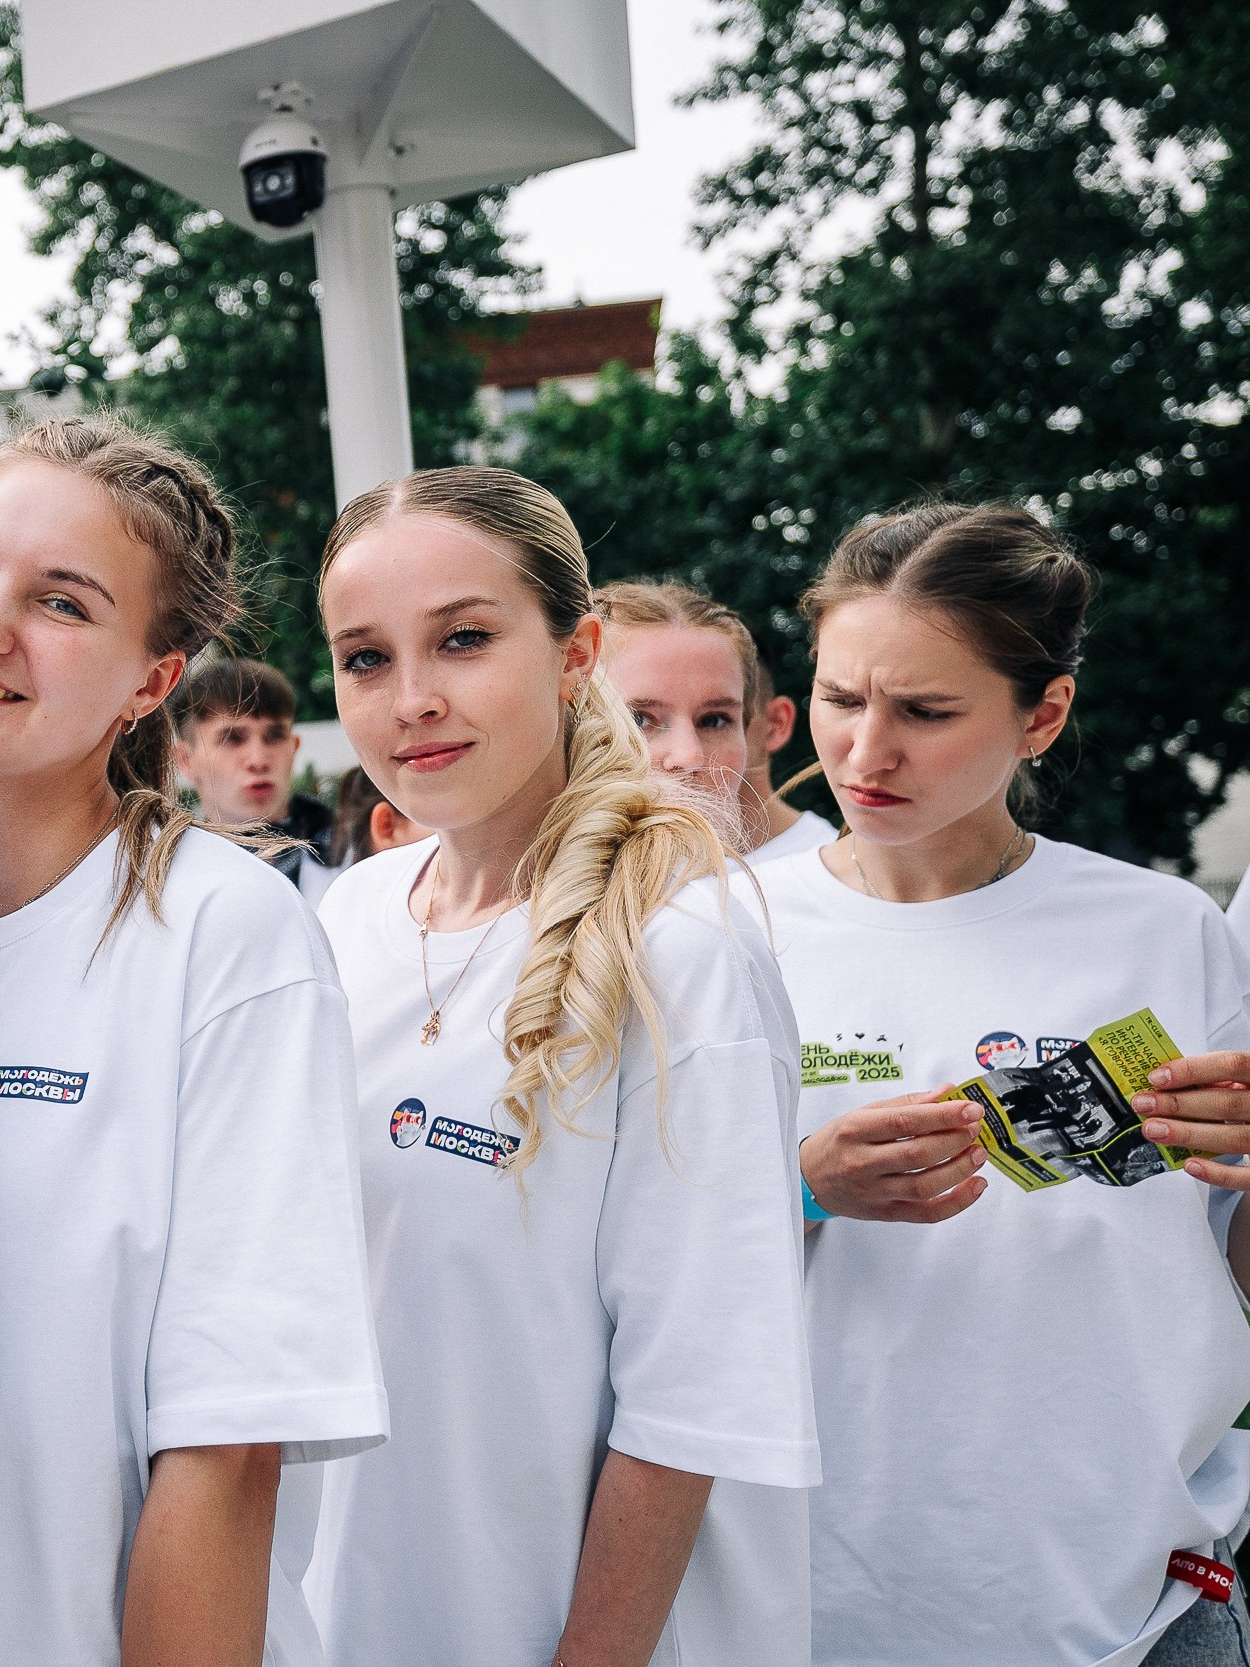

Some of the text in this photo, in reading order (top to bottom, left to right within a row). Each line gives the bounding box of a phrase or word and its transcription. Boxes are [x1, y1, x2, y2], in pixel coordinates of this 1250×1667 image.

[801, 1044, 830, 1056] ЕНЬ
[1041, 1040, 1081, 1050] МОЛ
[1115, 1028, 1151, 1071] ИНТЕНСИВ
[1106, 1032, 1120, 1045] ПО
[1116, 1045, 1135, 1065] РЕЧИ
[1131, 1065, 1141, 1073] И
[801, 1052, 891, 1068] ОЛОДЁЖИ
[1105, 1046, 1132, 1077] ГОВОРЮ
[858, 1067, 901, 1080] 2025
[1196, 1565, 1206, 1575] В
